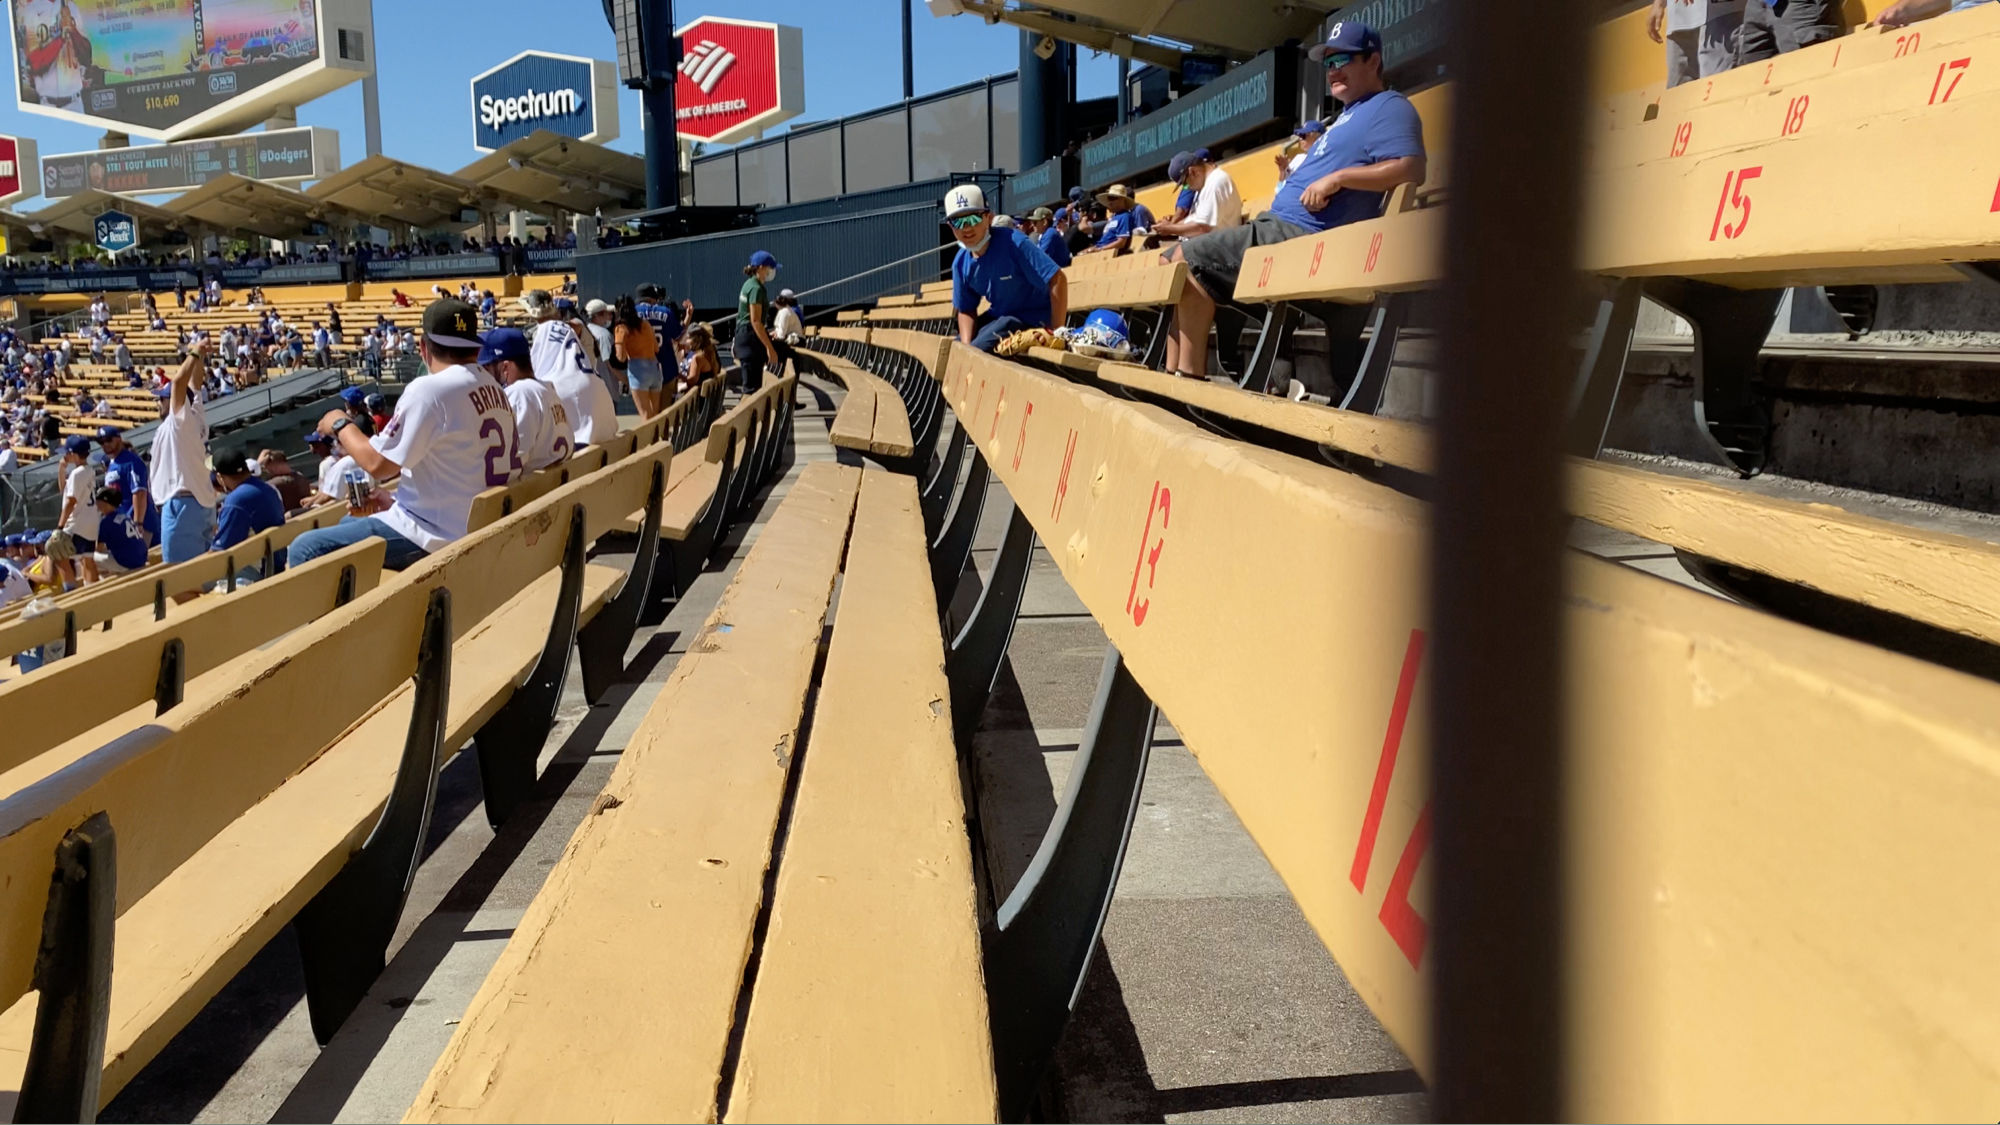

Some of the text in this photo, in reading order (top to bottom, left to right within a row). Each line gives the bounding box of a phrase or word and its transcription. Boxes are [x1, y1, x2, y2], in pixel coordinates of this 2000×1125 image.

[1329, 22, 1343, 40] B
[1928, 57, 1972, 105] 17
[145, 94, 180, 111] $10,690
[480, 88, 576, 131] Spectrum
[675, 98, 747, 120] NK OF AMERICA
[1782, 95, 1810, 136] 18
[259, 147, 309, 164] @Dodgers
[1671, 121, 1693, 157] 19
[956, 192, 968, 207] LA
[1709, 166, 1763, 241] 15
[1308, 240, 1325, 278] 19
[1364, 232, 1383, 273] 18
[1257, 256, 1274, 289] 20
[454, 313, 467, 332] LA
[1126, 480, 1171, 628] 13
